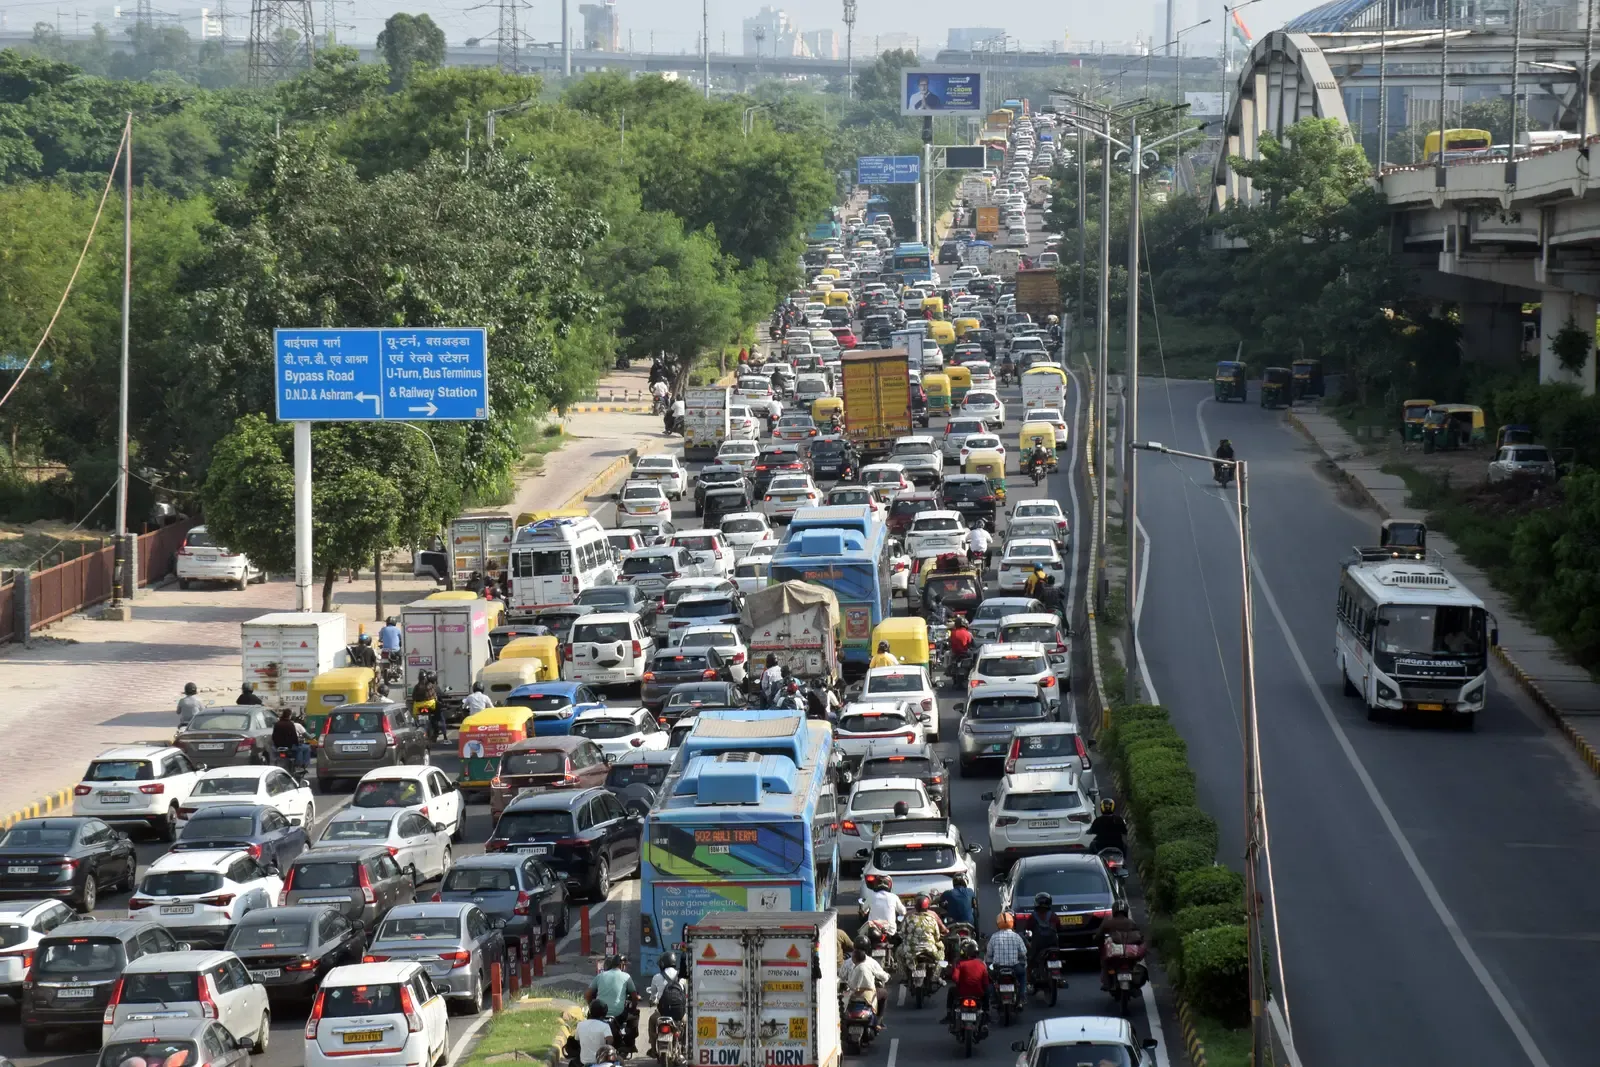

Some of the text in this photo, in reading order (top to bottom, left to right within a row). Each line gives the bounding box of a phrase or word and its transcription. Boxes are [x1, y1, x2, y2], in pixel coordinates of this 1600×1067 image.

[323, 336, 341, 348] मार्ग
[329, 353, 342, 366] एवं
[344, 355, 369, 364] आश्रम
[388, 352, 404, 364] एवं
[284, 370, 355, 384] Bypass Road
[386, 367, 482, 380] U-Turn, Bus Terminus
[319, 388, 354, 400] Ashram
[389, 386, 478, 400] & Railway Station
[665, 899, 685, 907] have
[686, 900, 707, 909] gone
[661, 908, 677, 916] how
[678, 908, 705, 916] about
[699, 1048, 804, 1066] BLOW HORN
